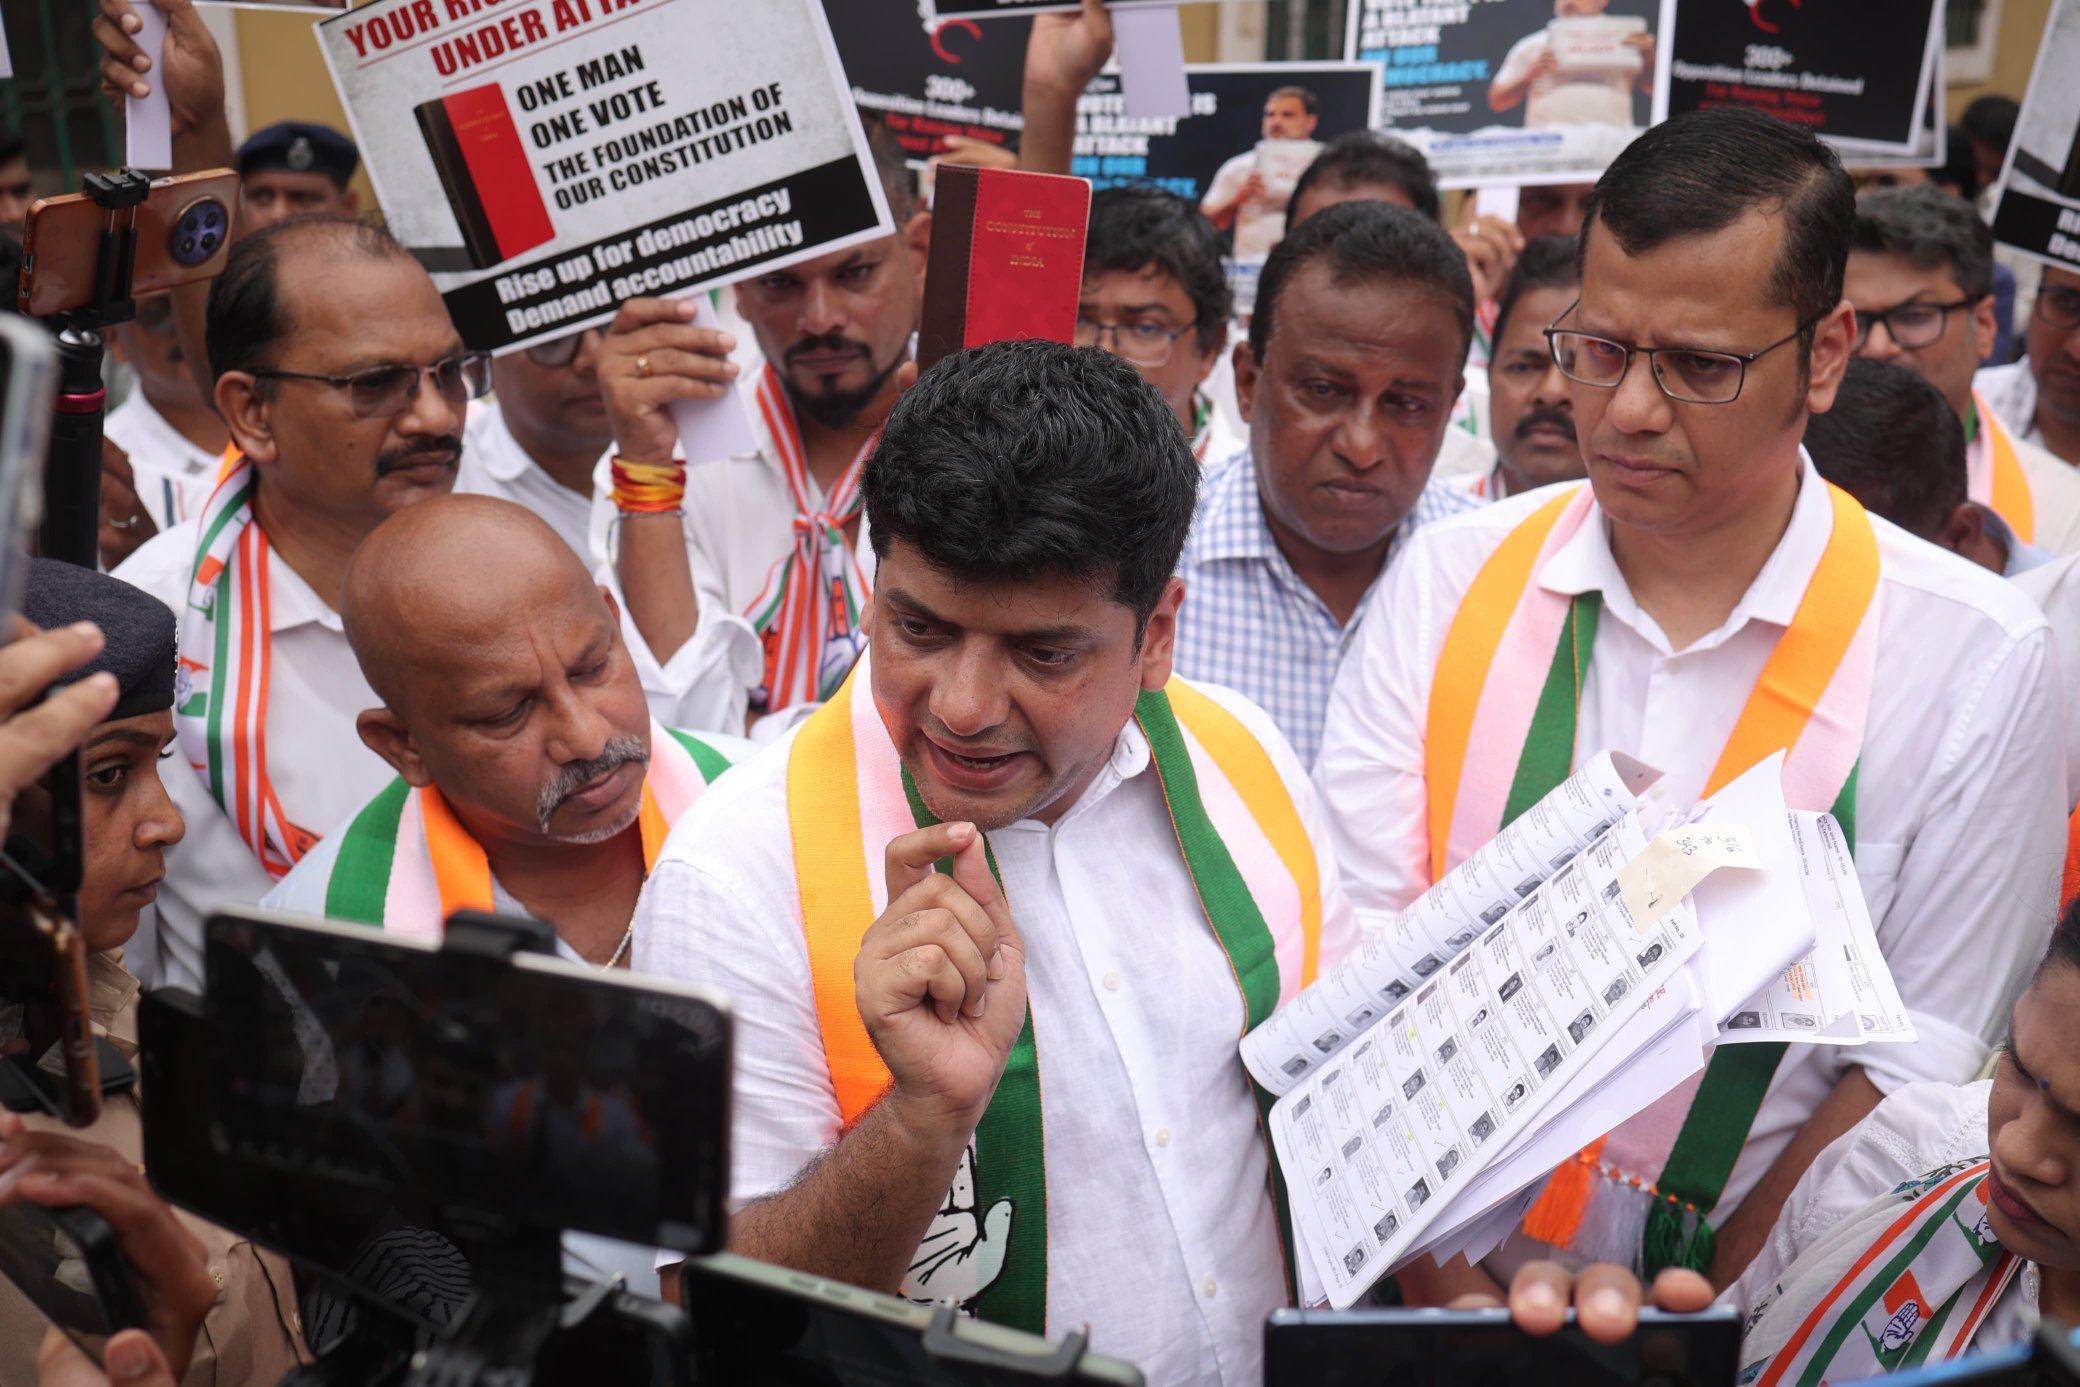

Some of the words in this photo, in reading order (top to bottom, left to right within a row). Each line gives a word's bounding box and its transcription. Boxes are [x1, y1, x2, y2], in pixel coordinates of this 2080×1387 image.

[345, 0, 440, 57] YOUR
[430, 8, 549, 77] UNDER
[516, 70, 575, 112] ONE
[576, 45, 645, 91] MAN
[531, 109, 588, 149] ONE
[589, 80, 666, 127] VOTE
[543, 151, 591, 184] THE
[592, 96, 748, 168] FOUNDATION
[751, 82, 784, 112] OF
[554, 176, 606, 211] OUR
[610, 111, 794, 192] CONSTITUTION
[495, 266, 556, 304] Rise
[556, 256, 595, 285] up
[593, 239, 635, 272] for
[635, 187, 792, 258] democracy
[506, 281, 612, 335] Demand
[612, 219, 804, 301] accountability
